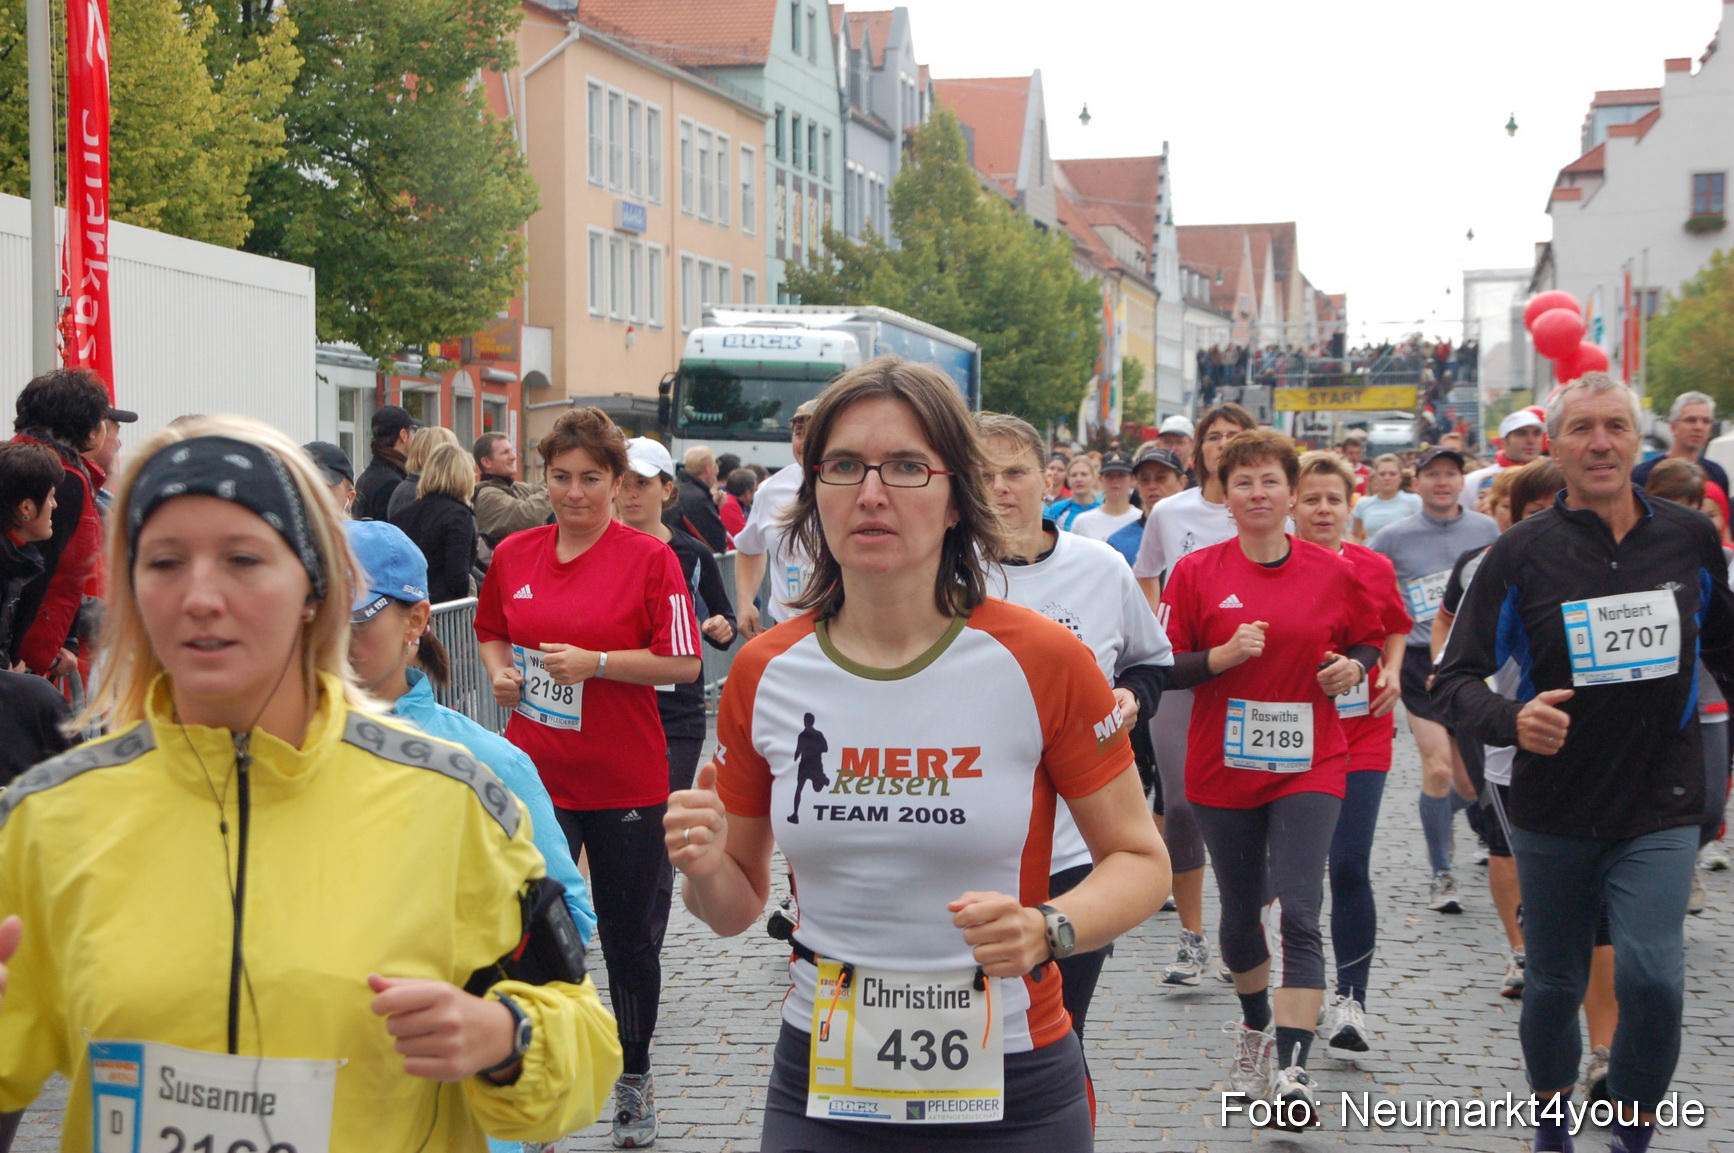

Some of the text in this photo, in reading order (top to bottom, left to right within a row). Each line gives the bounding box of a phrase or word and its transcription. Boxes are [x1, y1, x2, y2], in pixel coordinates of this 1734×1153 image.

[723, 334, 802, 349] BOCK
[1309, 391, 1363, 406] START
[364, 597, 389, 618] Est. 1972
[1598, 604, 1653, 621] Norbert
[1604, 624, 1668, 652] 2707
[530, 676, 574, 705] 2198
[1251, 708, 1299, 722] Roswitha
[1251, 729, 1304, 748] 2189
[841, 746, 983, 779] MERZ
[829, 768, 951, 796] Reisen
[813, 805, 966, 825] TEAM 2008
[863, 977, 970, 1010] Christine
[877, 1028, 969, 1071] 436
[159, 1064, 277, 1116] Susanne
[829, 1100, 878, 1113] BOCK
[928, 1099, 1000, 1112] PFLEIDERER
[111, 1109, 123, 1135] D
